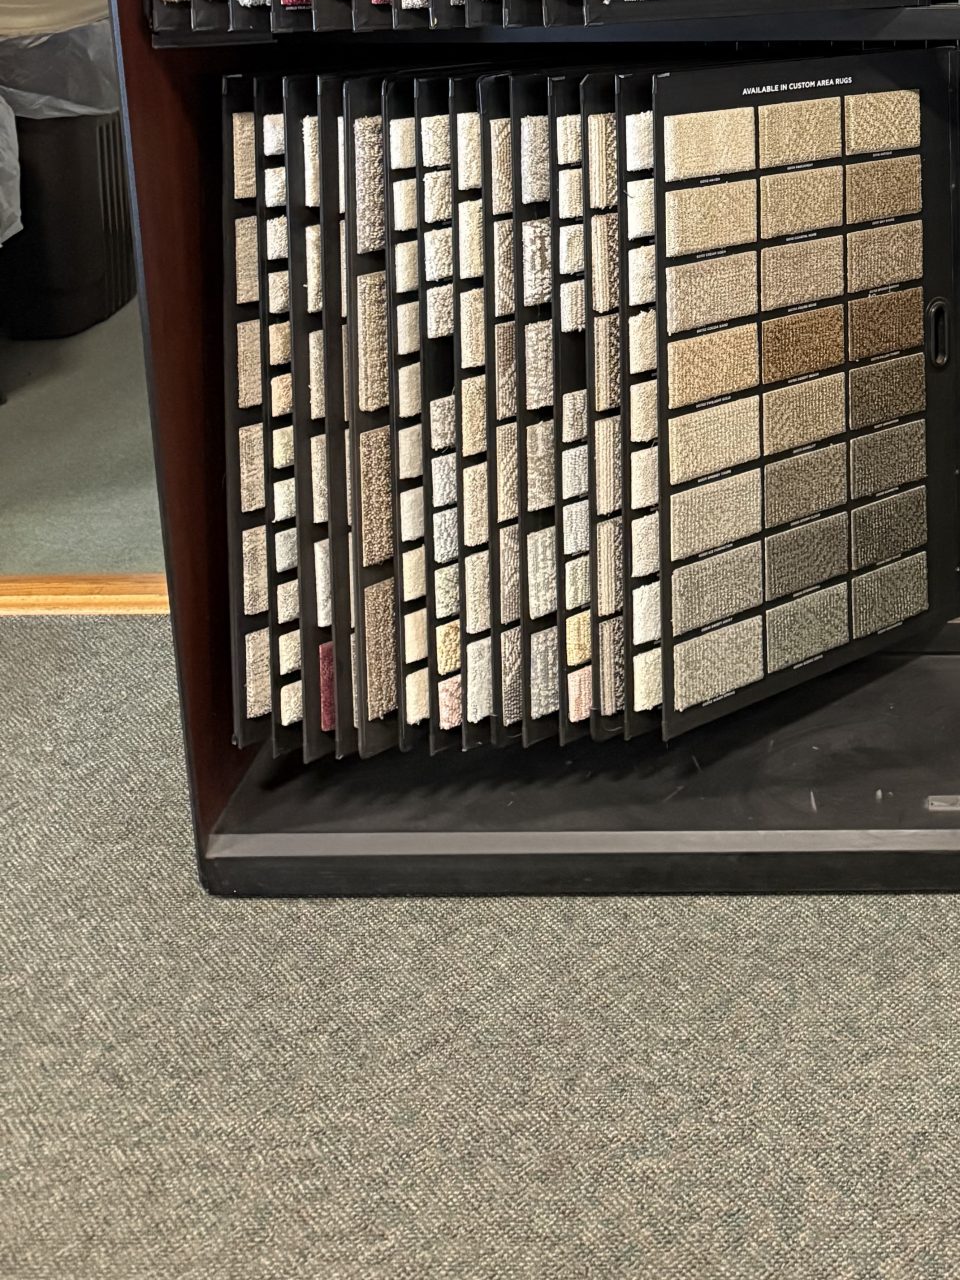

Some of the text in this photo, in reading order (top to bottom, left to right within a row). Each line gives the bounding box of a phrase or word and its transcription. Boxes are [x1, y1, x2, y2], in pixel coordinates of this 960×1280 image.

[742, 76, 853, 95] AVAILABLE IN CUSTOM AREA RUGS
